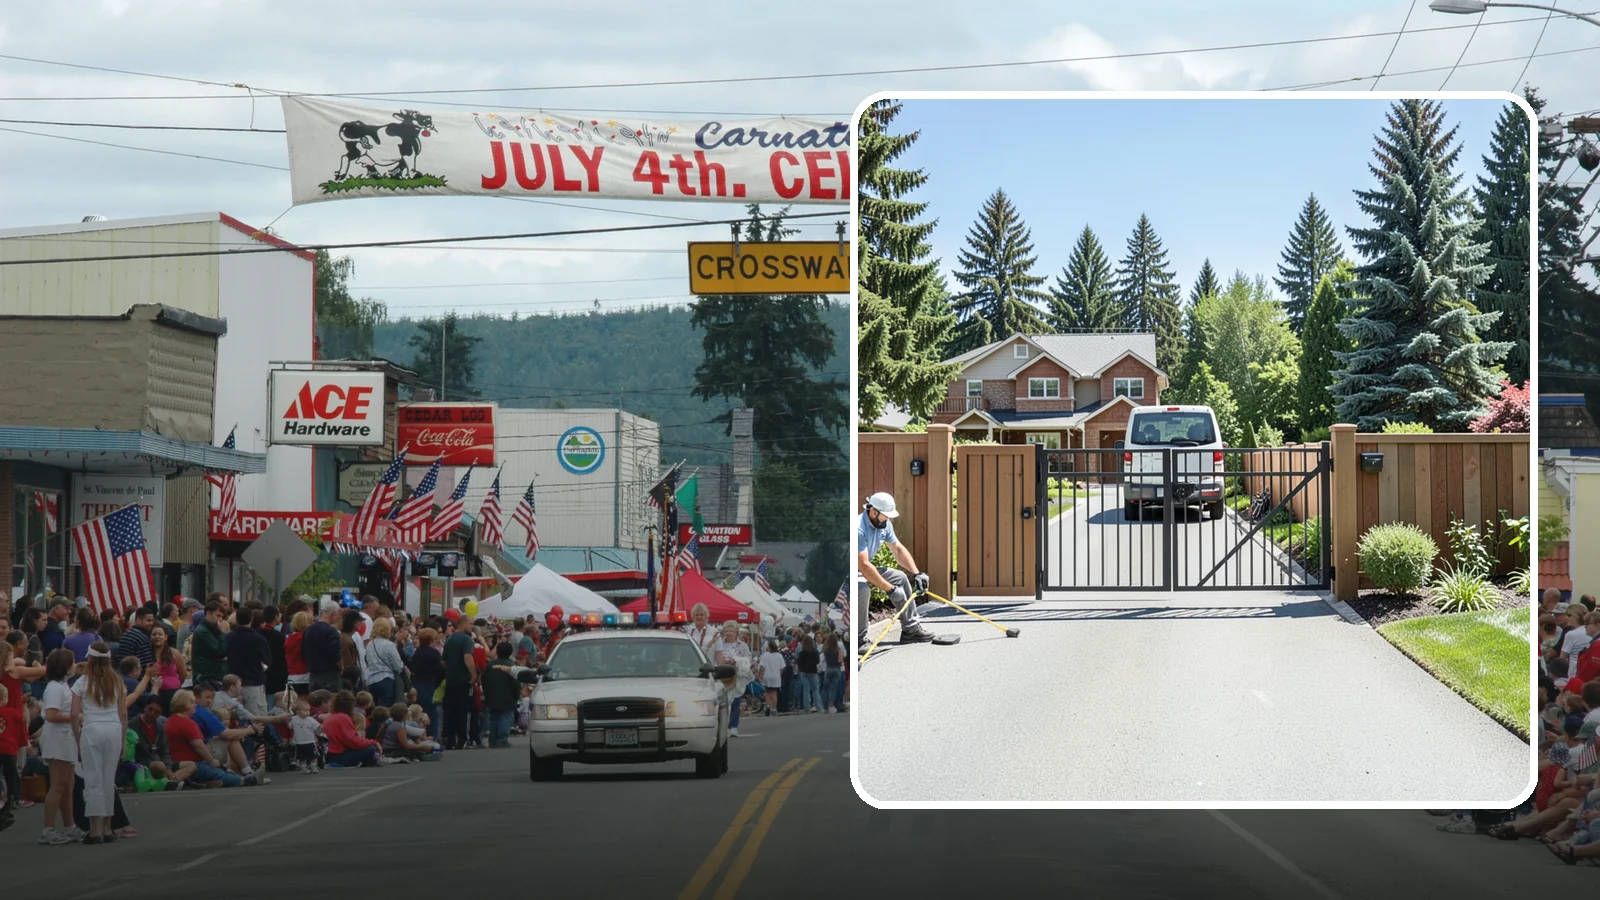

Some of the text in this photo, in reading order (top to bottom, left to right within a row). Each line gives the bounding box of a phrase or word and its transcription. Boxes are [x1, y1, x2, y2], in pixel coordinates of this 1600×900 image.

[481, 141, 605, 192] JULY
[633, 150, 746, 197] 4th.
[283, 380, 374, 420] ACE
[406, 409, 485, 421] CEDAR LOG
[283, 421, 371, 437] Hardware
[416, 428, 476, 447] Coca-Cola
[95, 485, 124, 494] Vincent
[126, 486, 135, 495] de
[137, 486, 155, 495] Paul
[81, 503, 154, 521] THT
[212, 516, 331, 535] HARDARE
[688, 526, 741, 535] CRNATION
[699, 535, 730, 543] GLASS
